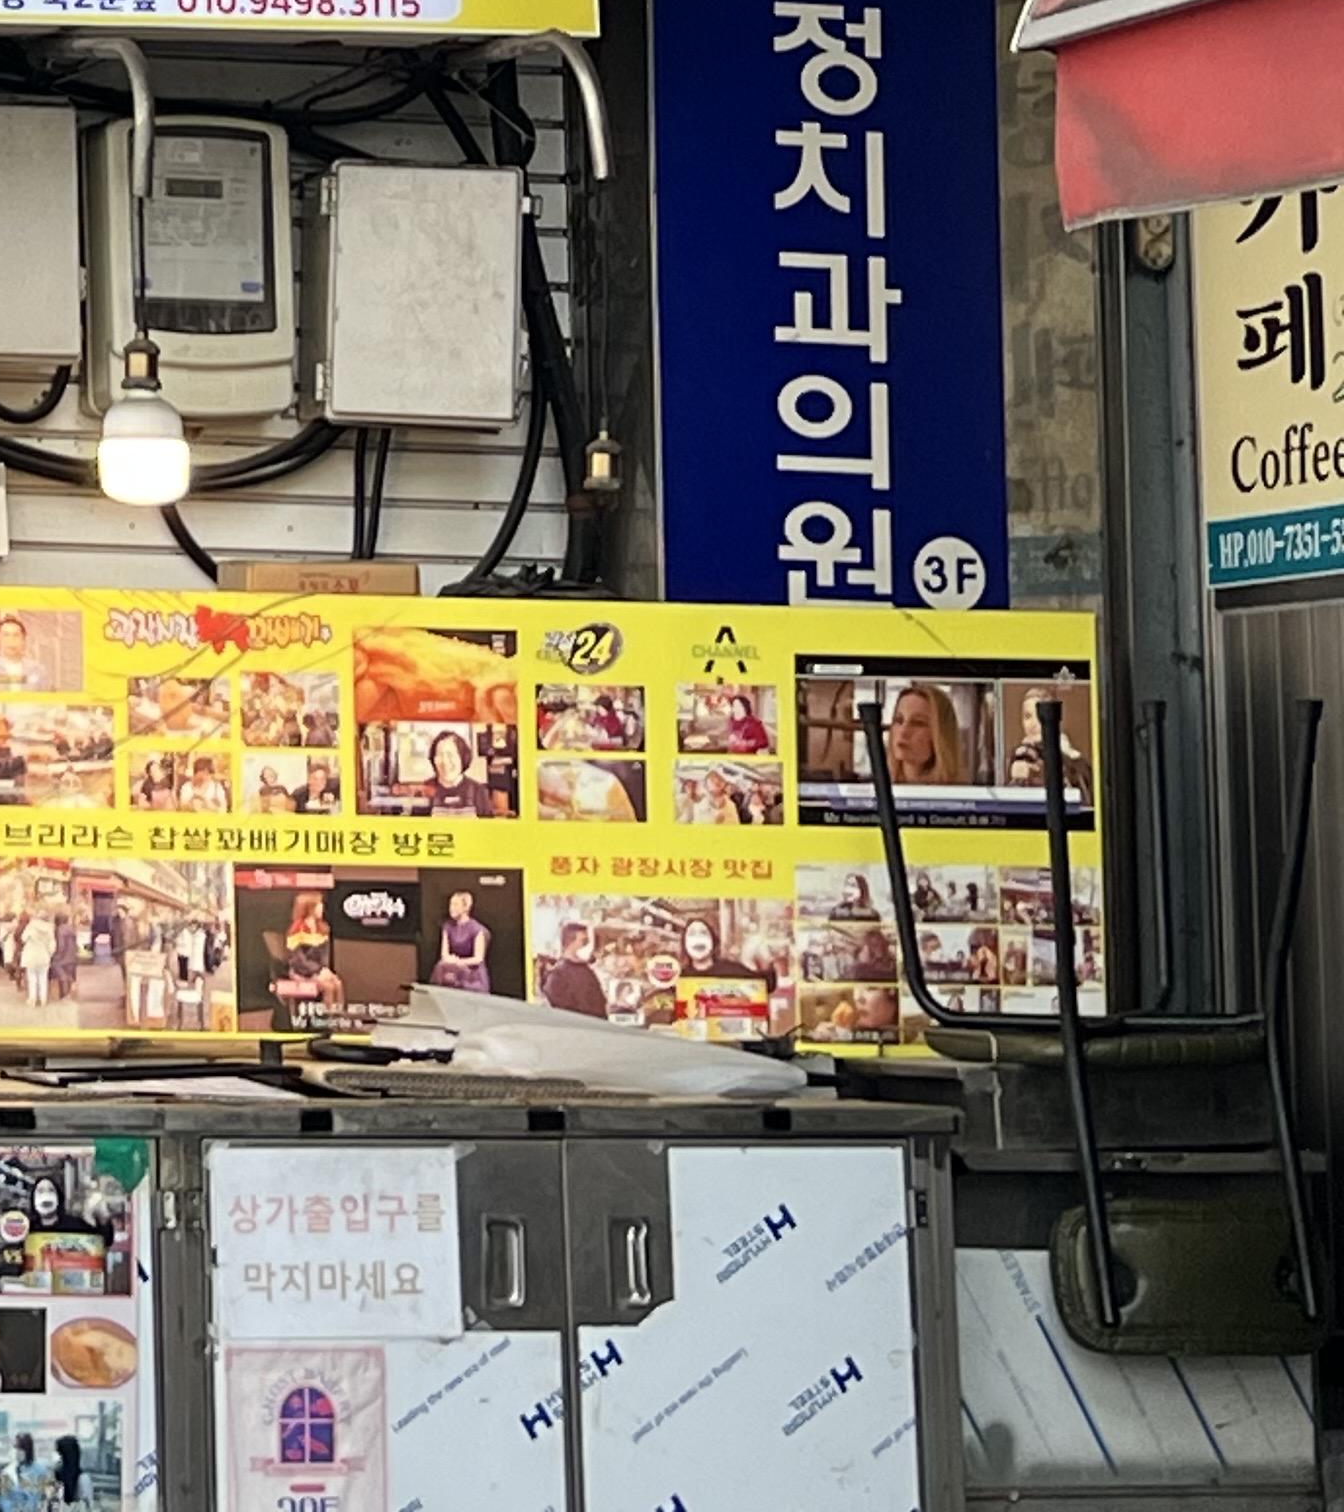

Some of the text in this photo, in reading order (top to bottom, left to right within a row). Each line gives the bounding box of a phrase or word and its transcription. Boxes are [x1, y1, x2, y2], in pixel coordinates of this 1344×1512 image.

[771, 0, 904, 608] 정치과의원
[919, 554, 981, 597] 3F
[2, 823, 457, 857] 브리라슨 찹쌀꽈배기매장 방문
[610, 856, 714, 879] 광장시장
[722, 859, 774, 880] 맛집
[227, 1191, 447, 1235] 상가출입구를
[241, 1259, 426, 1305] 막지마세요
